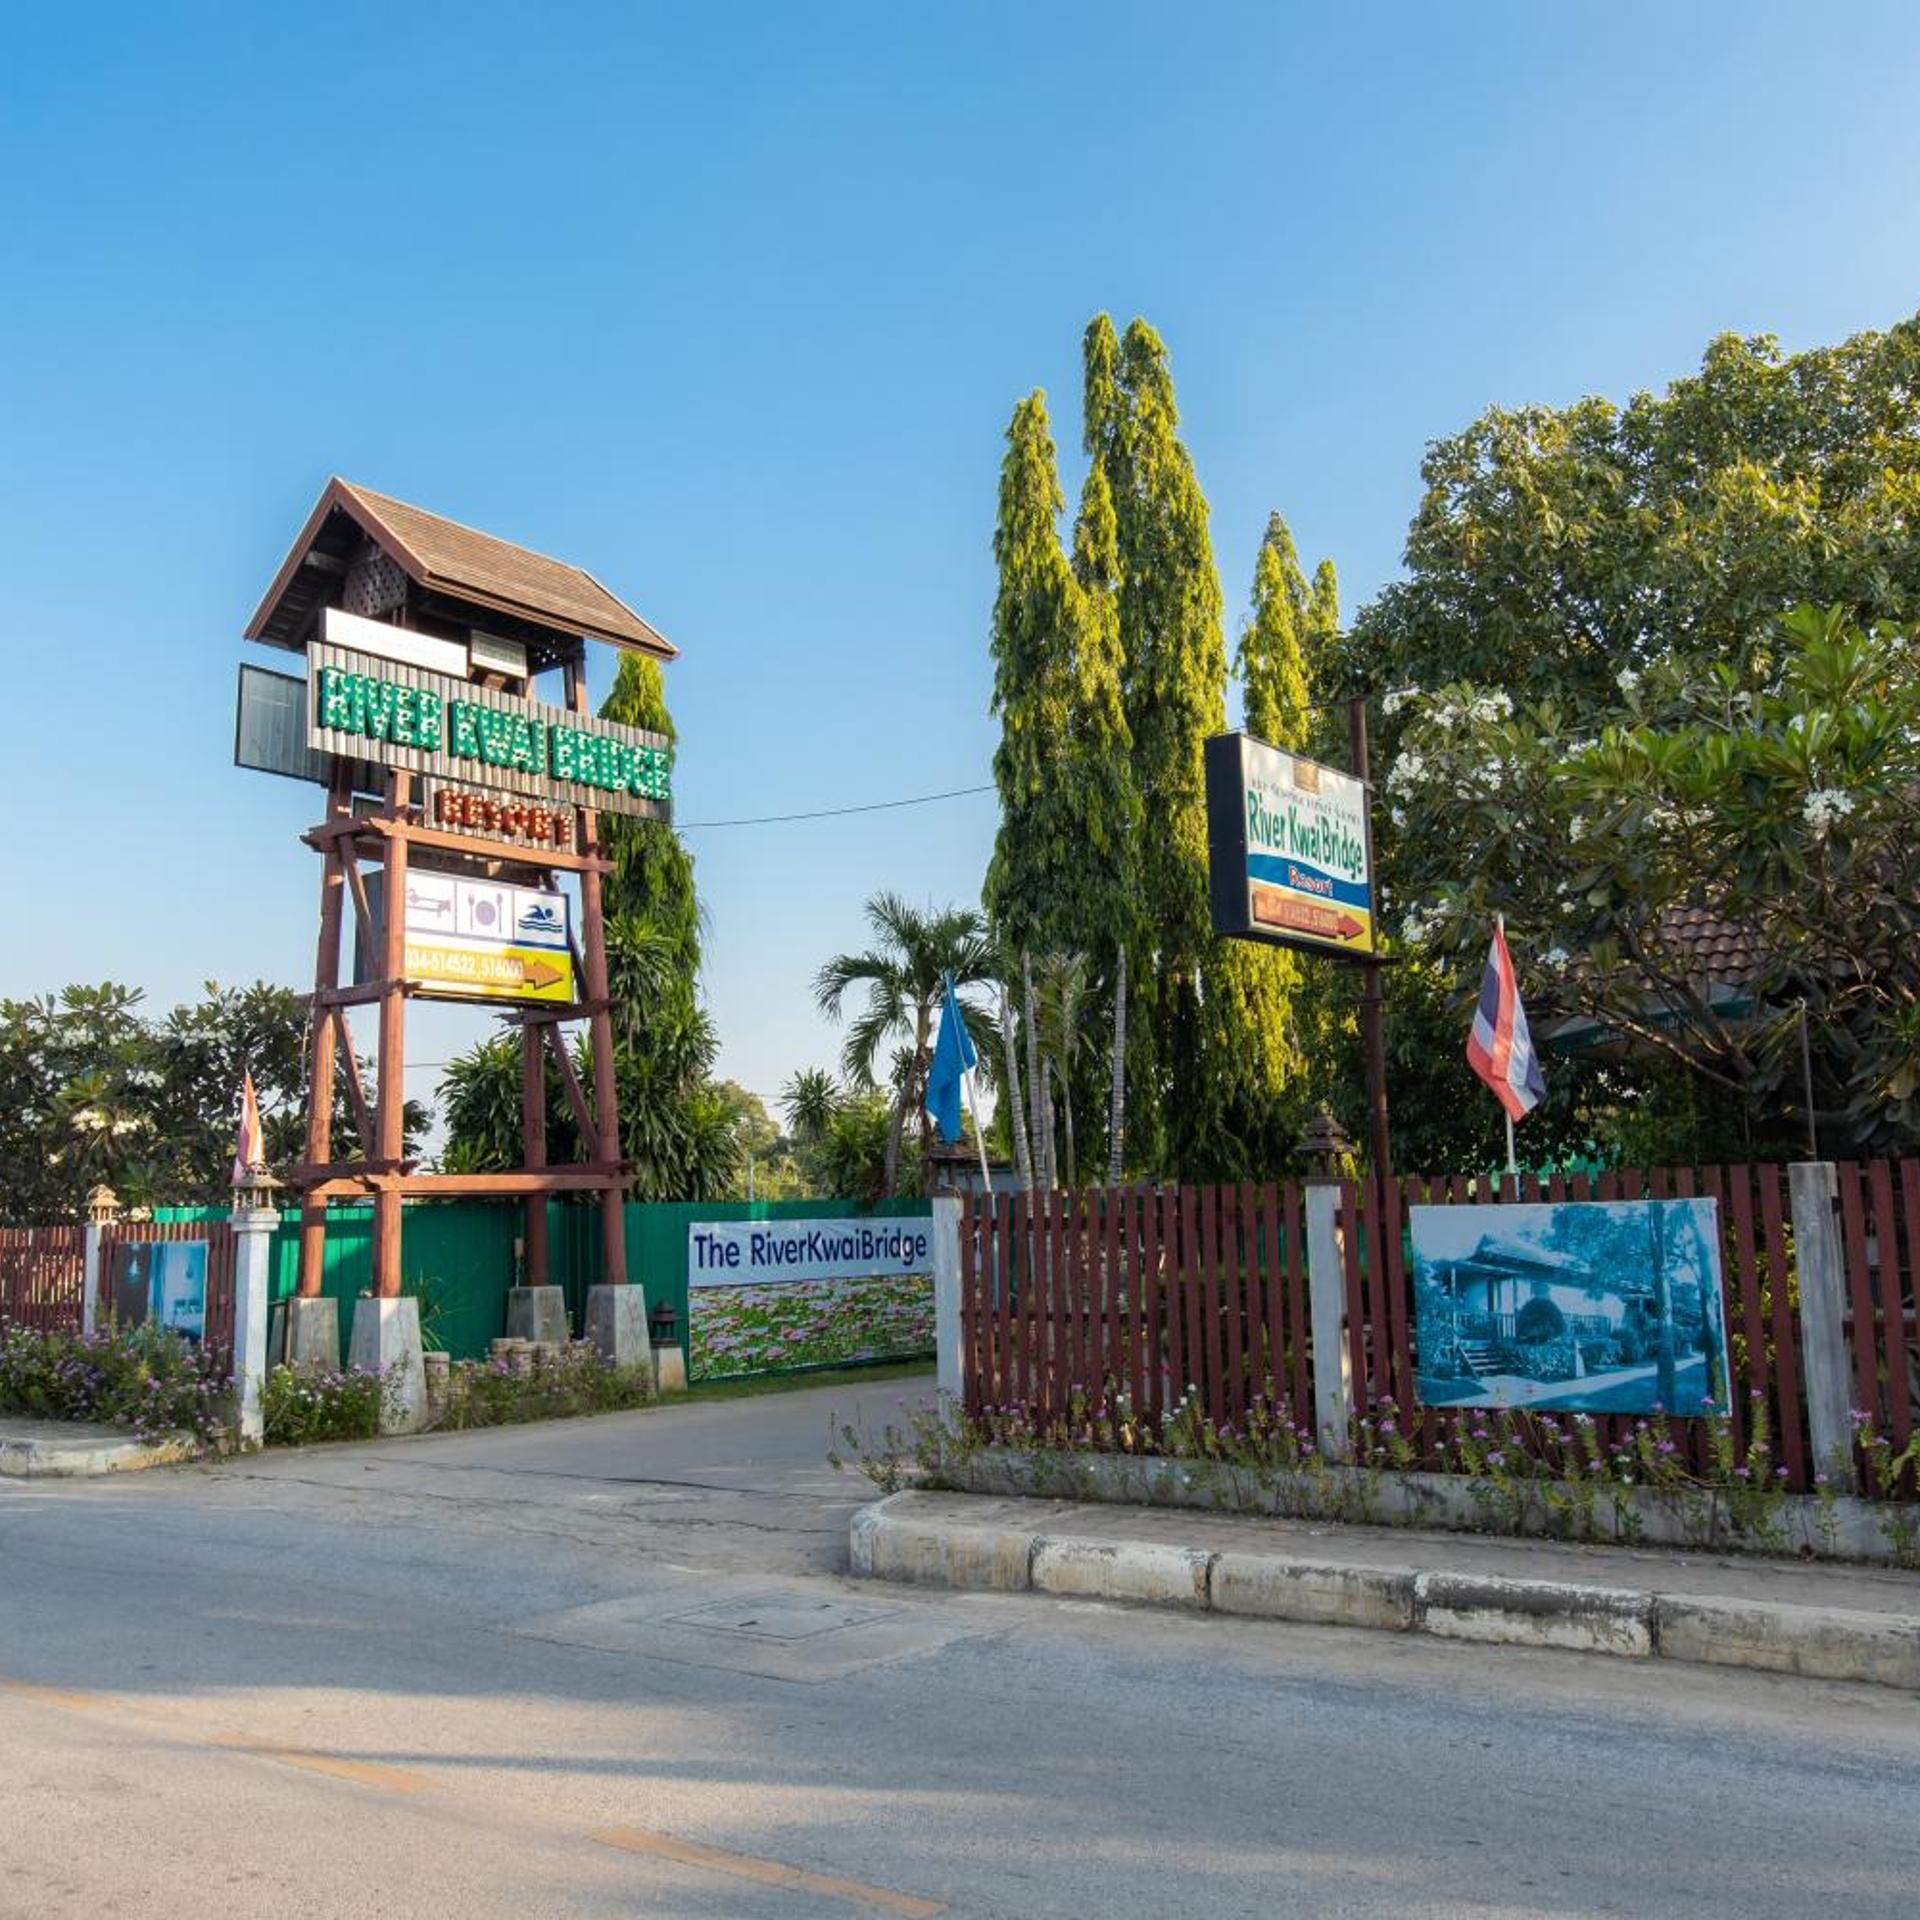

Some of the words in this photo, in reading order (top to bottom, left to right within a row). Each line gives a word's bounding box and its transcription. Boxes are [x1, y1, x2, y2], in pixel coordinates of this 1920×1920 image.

[319, 666, 442, 752] RIVER
[447, 699, 546, 776] KWAI
[549, 723, 673, 801] BRIDGE
[434, 789, 573, 845] RESORT
[1247, 790, 1286, 849] River
[1288, 864, 1333, 897] Resort
[694, 1232, 741, 1268] The
[750, 1228, 927, 1267] RiverKwaiBridge
